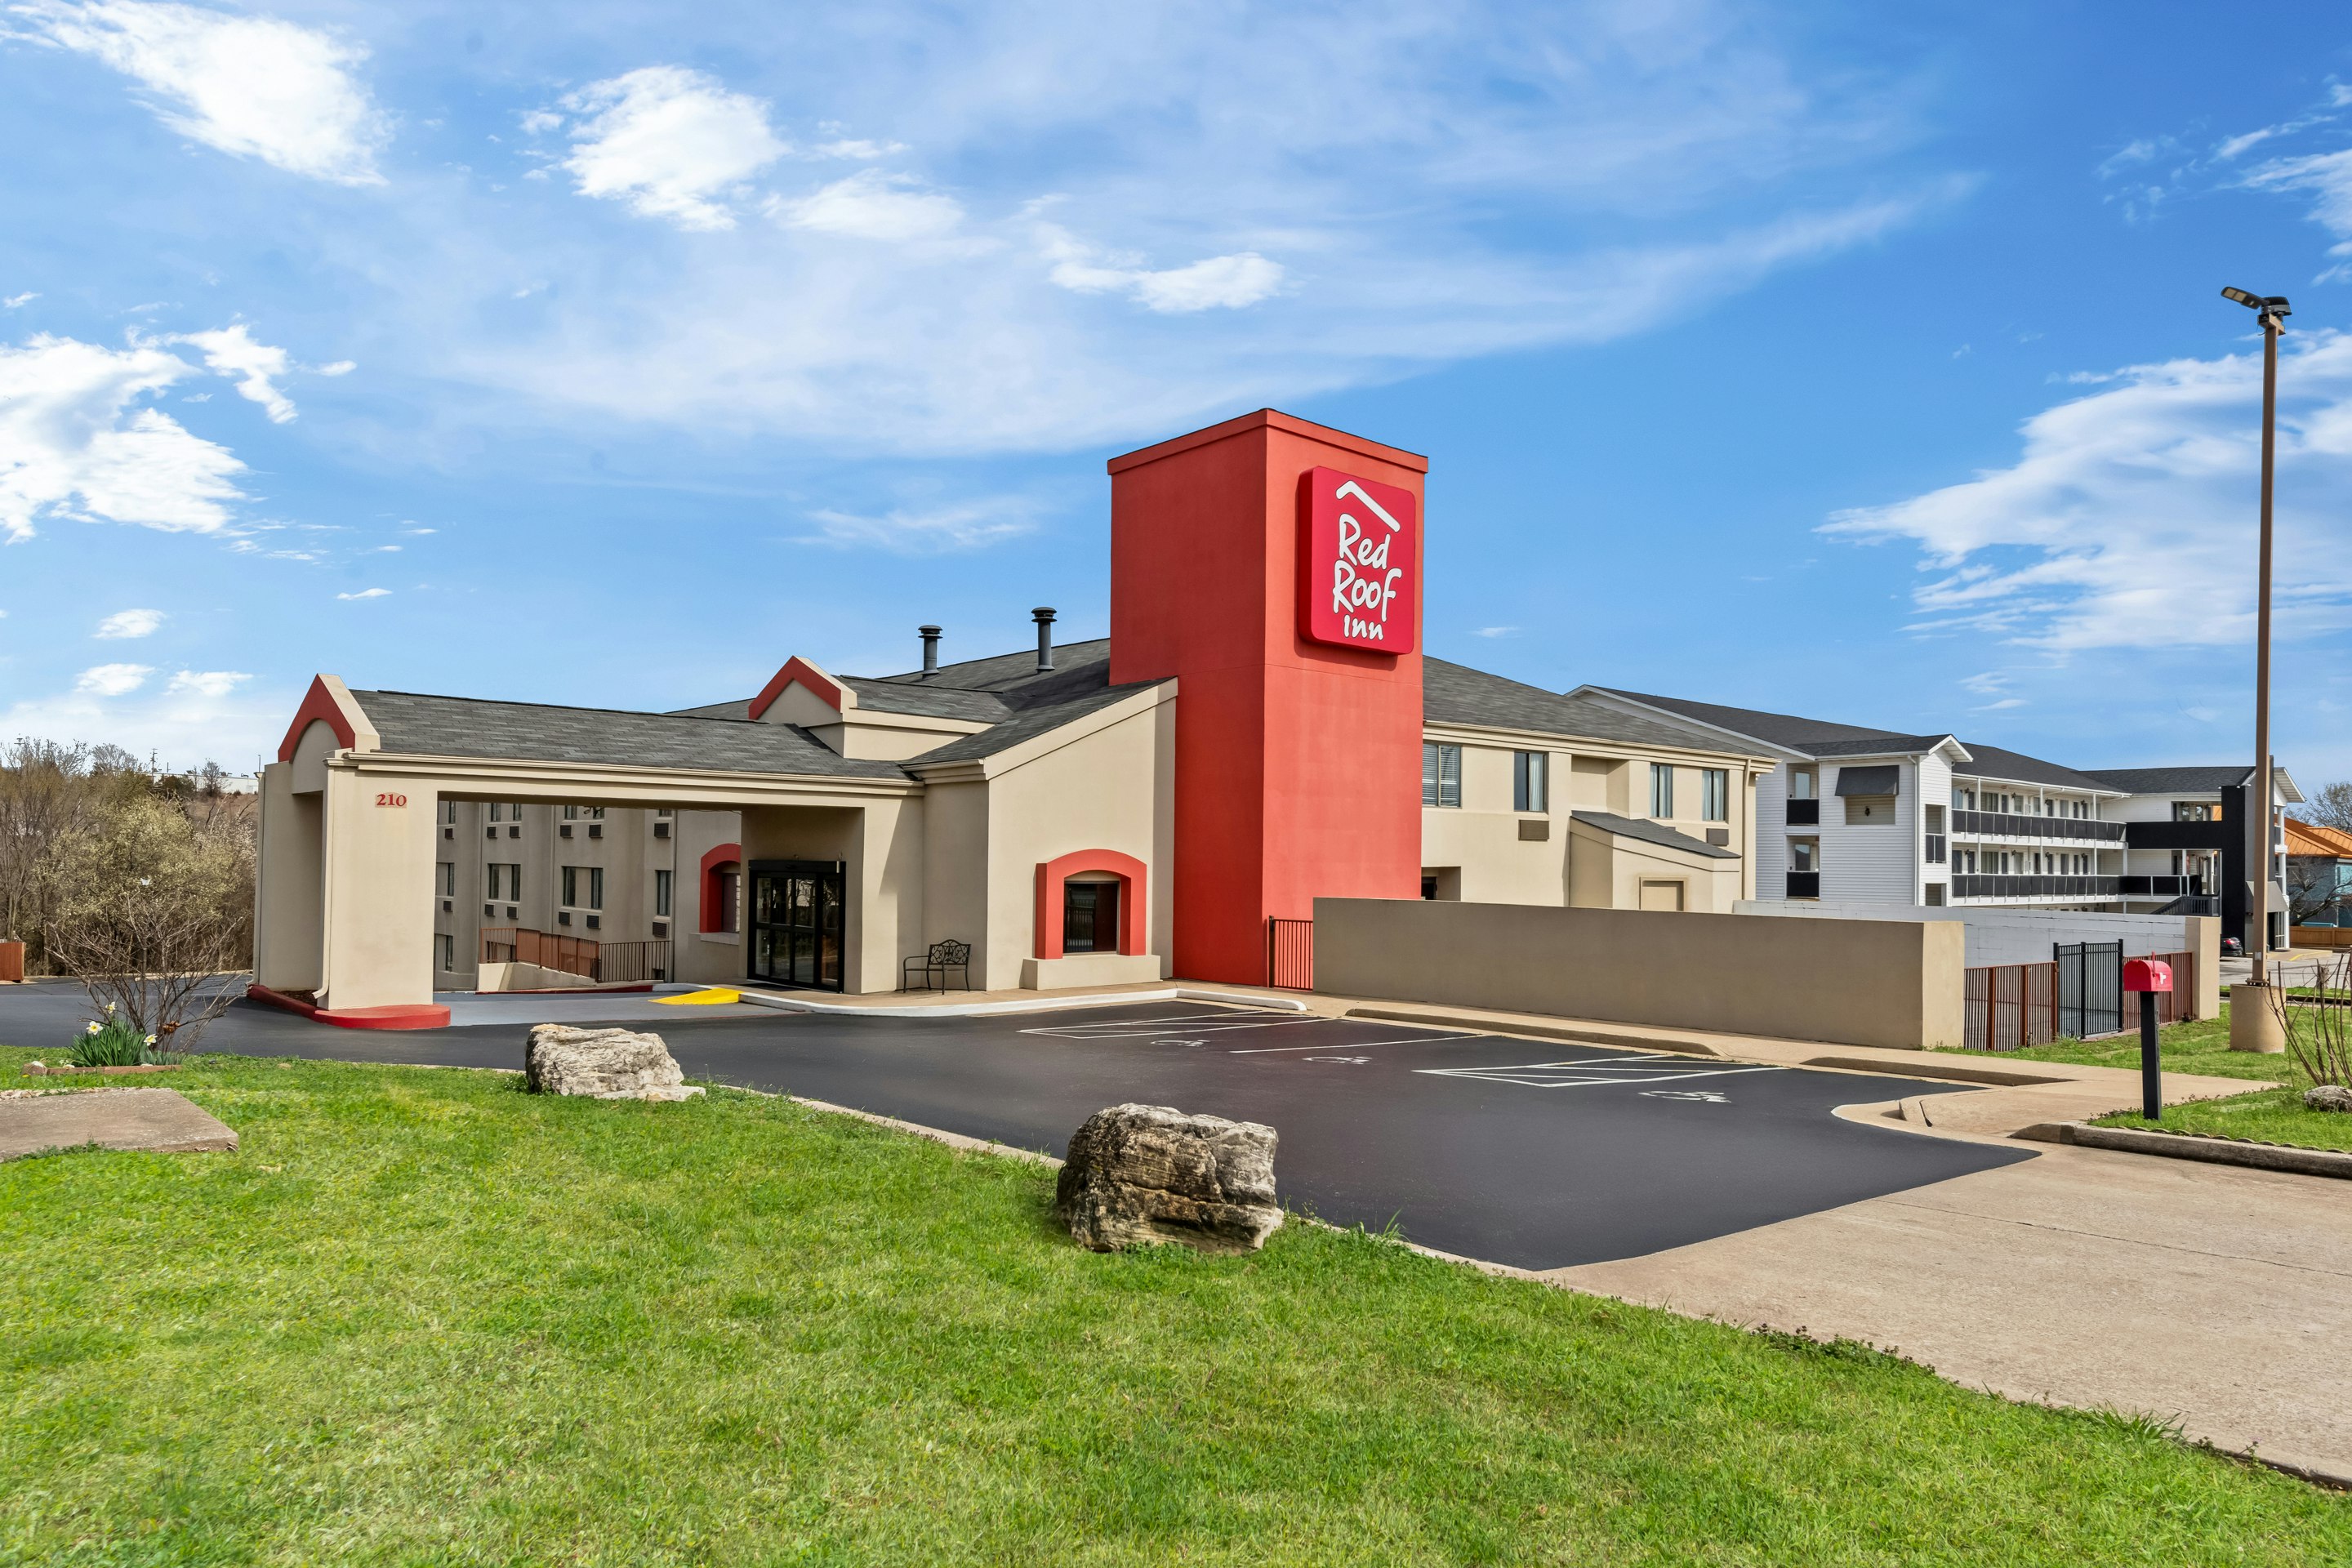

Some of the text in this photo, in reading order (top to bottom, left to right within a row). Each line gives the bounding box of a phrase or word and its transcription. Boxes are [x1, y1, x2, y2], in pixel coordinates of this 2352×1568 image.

[1339, 513, 1391, 569] Red
[1333, 559, 1402, 621] Roof
[376, 793, 407, 807] 210
